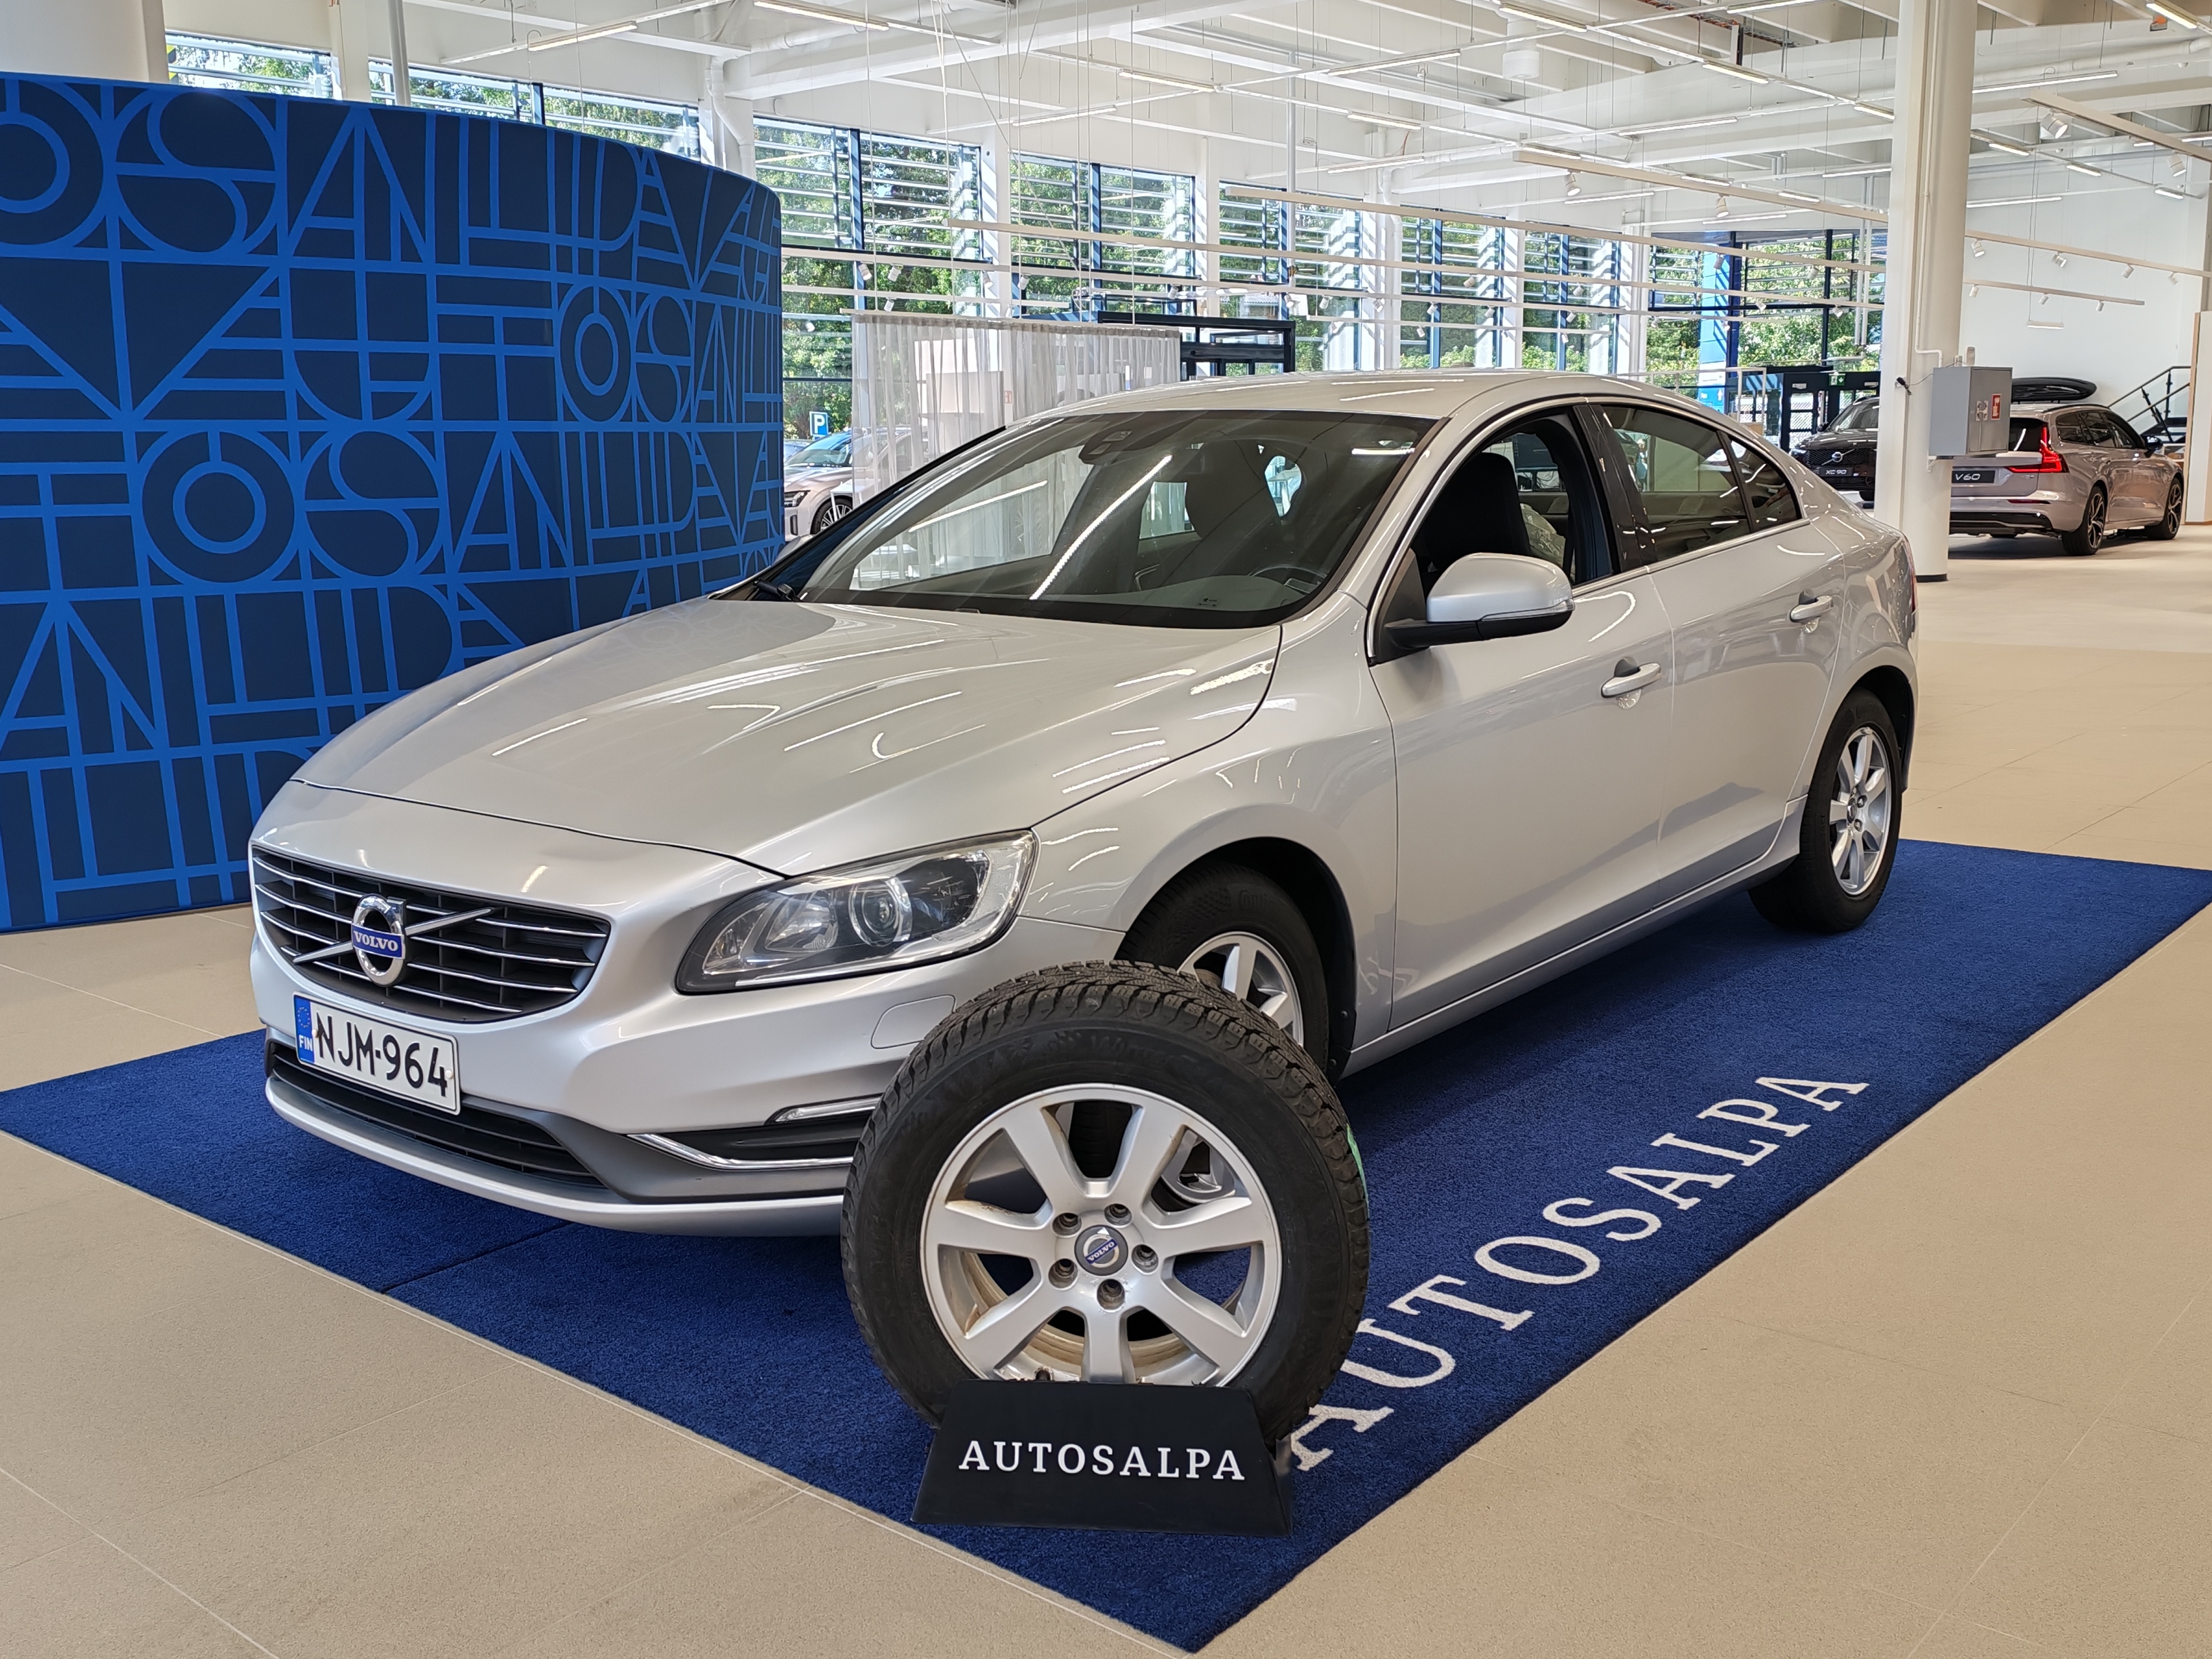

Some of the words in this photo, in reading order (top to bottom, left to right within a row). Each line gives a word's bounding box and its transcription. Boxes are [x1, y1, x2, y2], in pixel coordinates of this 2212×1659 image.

[814, 414, 825, 434] P
[353, 930, 399, 952] VOLVO
[299, 1034, 313, 1052] FIN
[316, 1011, 448, 1097] NJM-964
[1087, 1241, 1115, 1261] VOLVO
[958, 1440, 1245, 1480] AUTOSALPA
